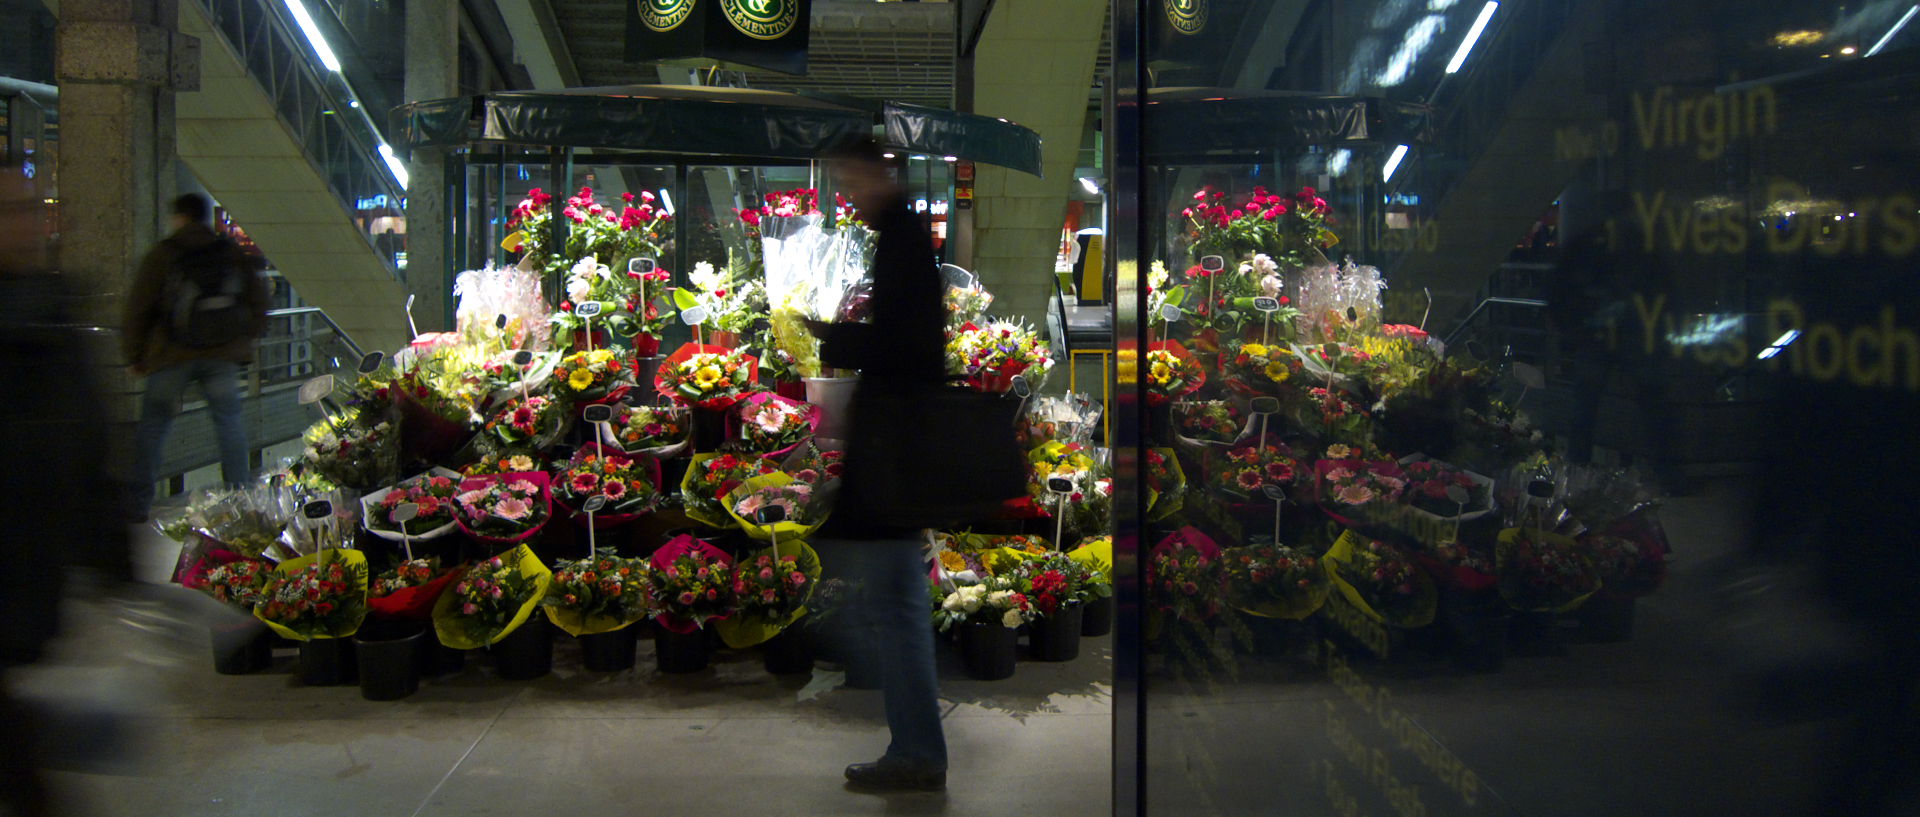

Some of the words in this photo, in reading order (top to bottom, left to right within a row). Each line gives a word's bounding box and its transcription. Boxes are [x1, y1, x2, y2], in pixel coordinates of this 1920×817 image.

[1632, 72, 1777, 160] Virgin
[1633, 189, 1747, 253] Yves
[1633, 293, 1748, 367] Yves
